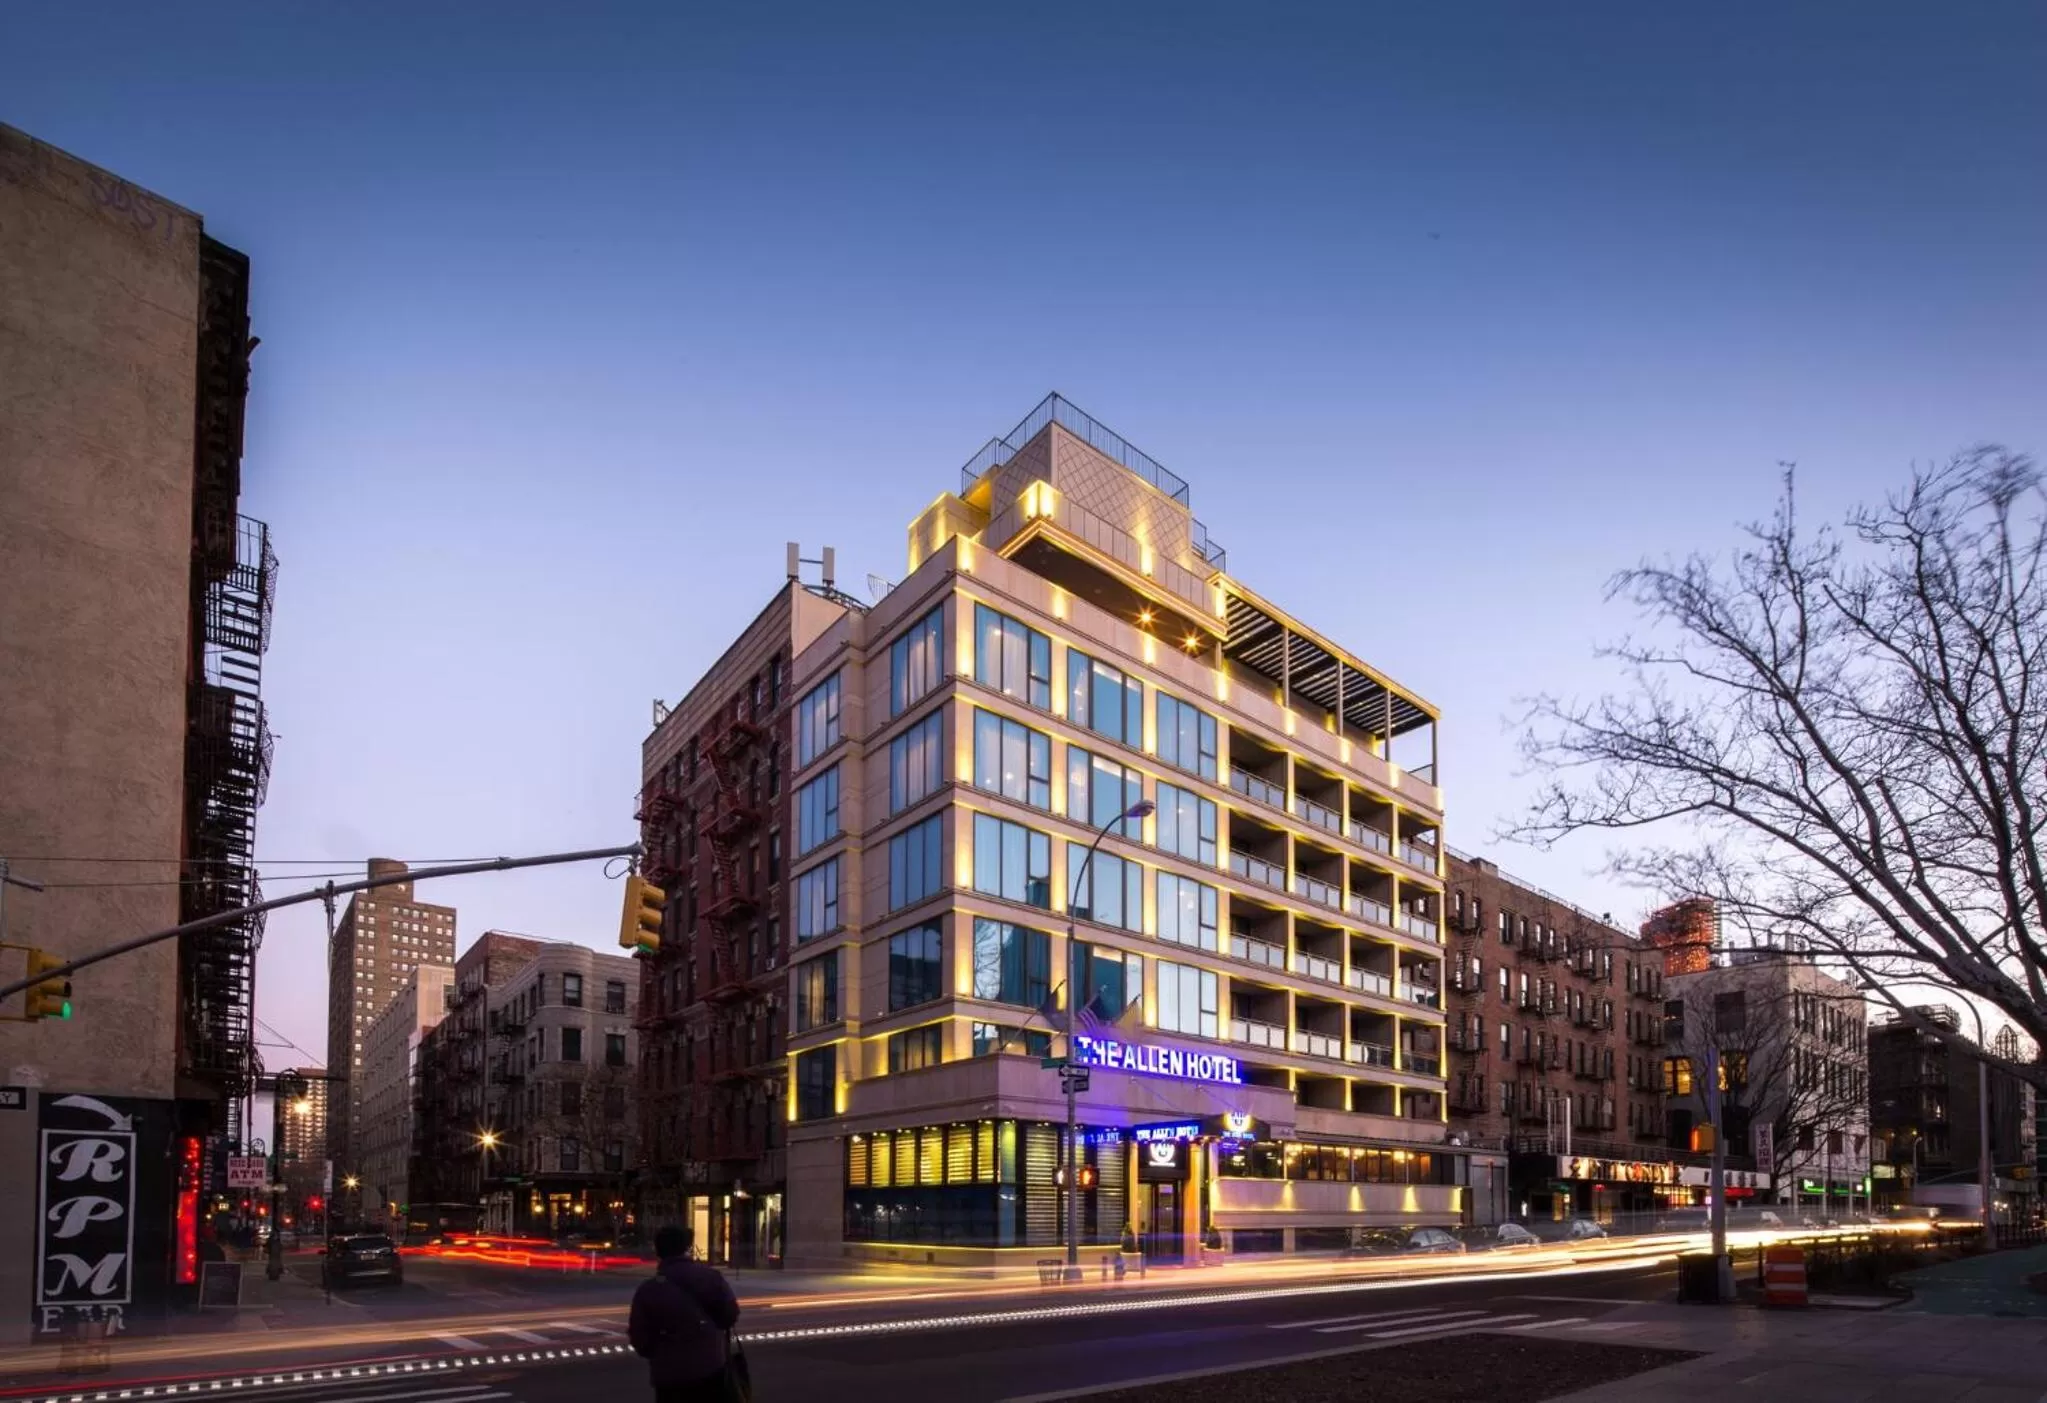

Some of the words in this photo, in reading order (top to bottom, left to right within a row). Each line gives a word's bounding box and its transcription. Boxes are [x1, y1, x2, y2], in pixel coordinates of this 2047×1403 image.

[1078, 1037, 1119, 1067] THE
[1123, 1045, 1183, 1077] ALLEN
[1188, 1055, 1241, 1084] HOTEL
[231, 1169, 263, 1179] ATM
[46, 1139, 127, 1295] RPM
